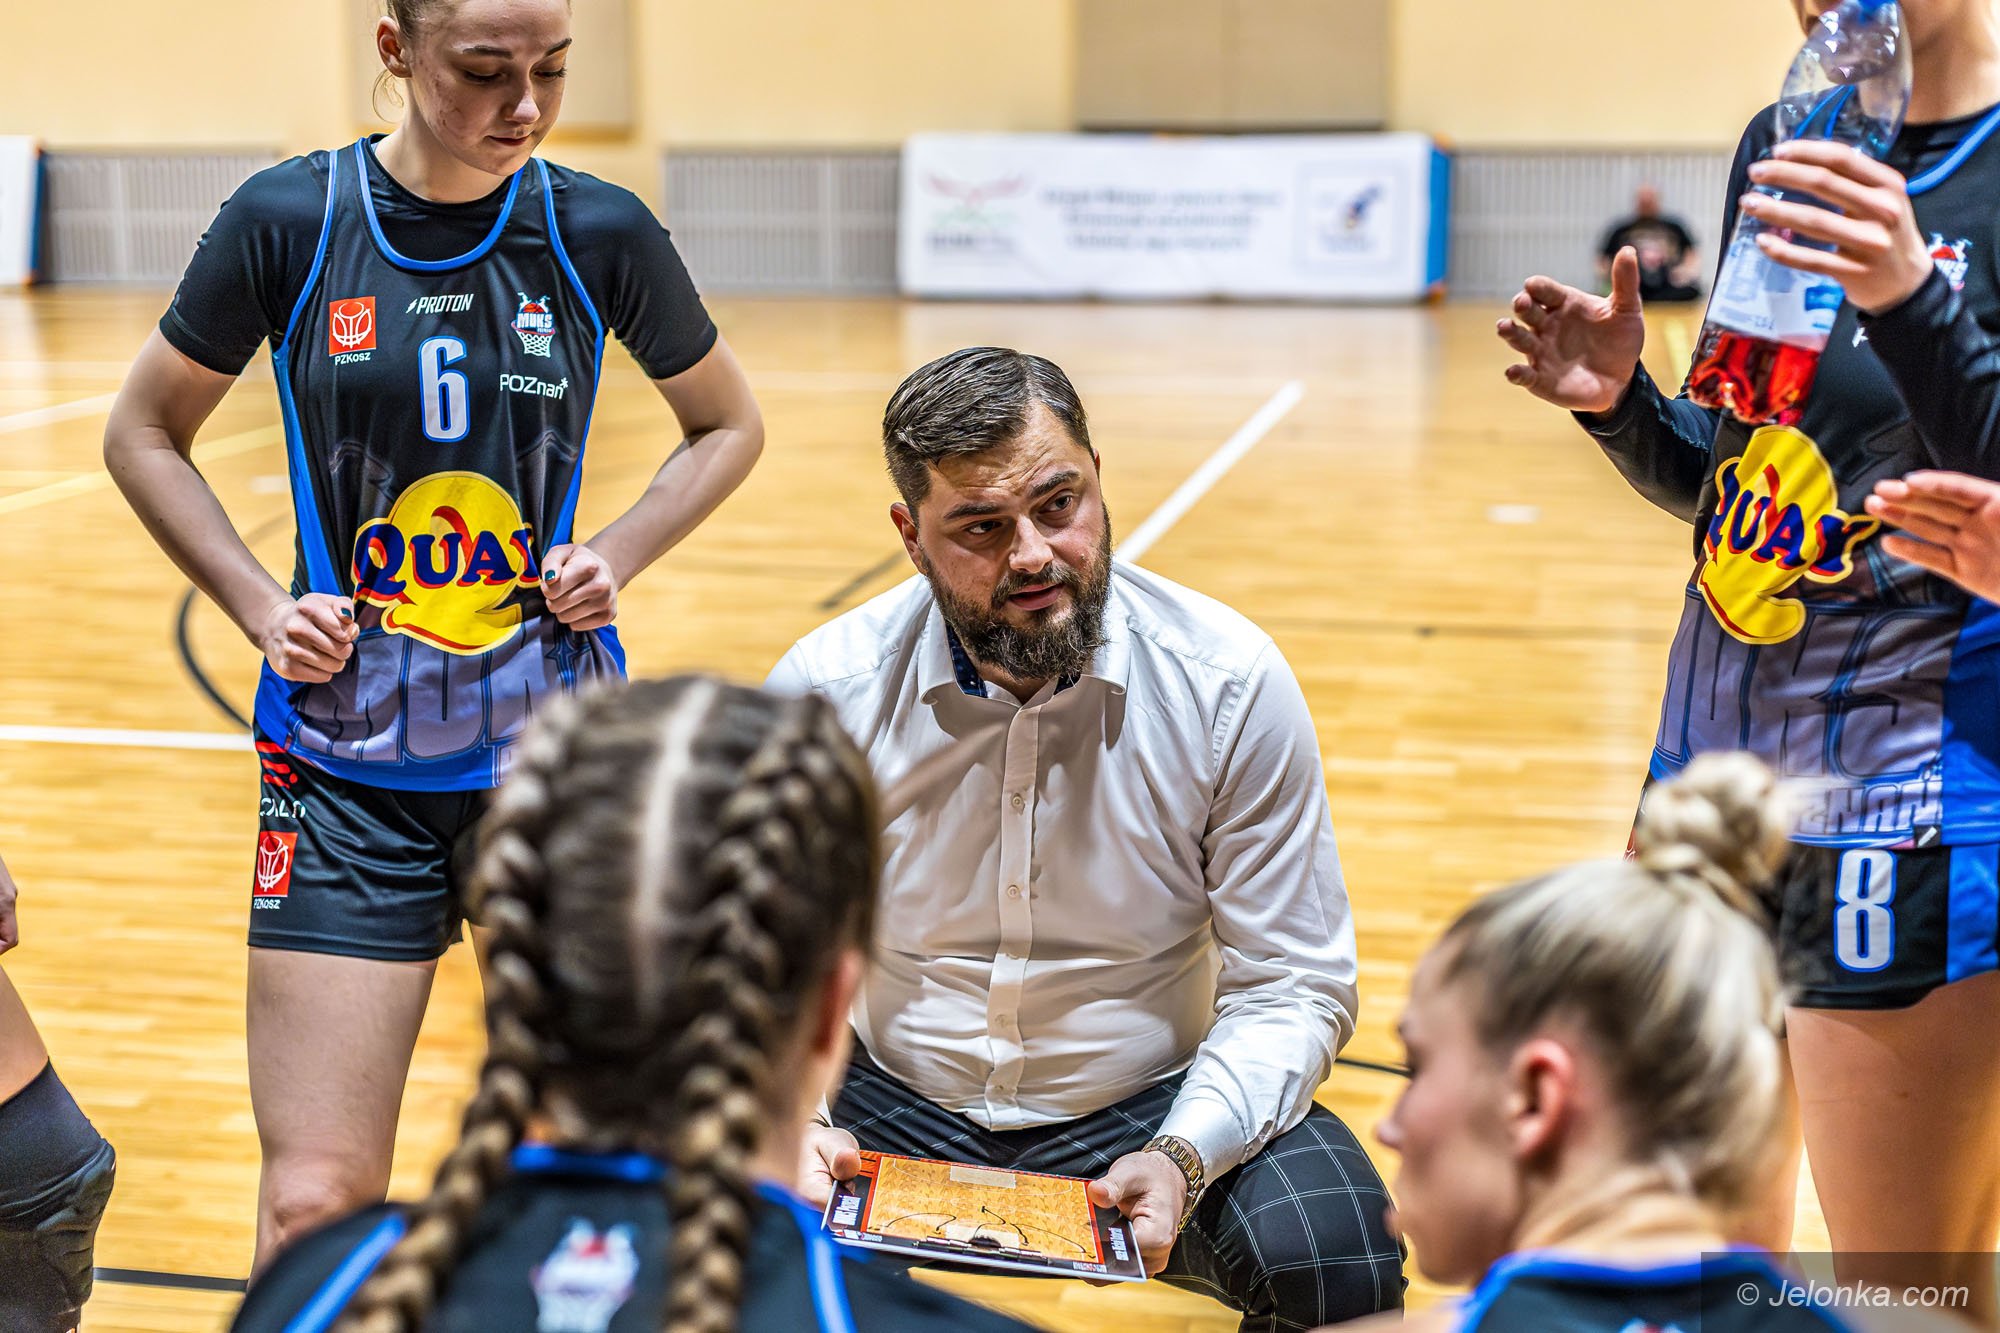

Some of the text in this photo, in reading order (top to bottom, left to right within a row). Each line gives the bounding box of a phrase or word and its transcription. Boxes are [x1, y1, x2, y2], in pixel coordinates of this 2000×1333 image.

[416, 294, 474, 314] PROTON
[517, 313, 552, 329] MUKS
[420, 336, 470, 442] 6
[1834, 847, 1897, 973] 8
